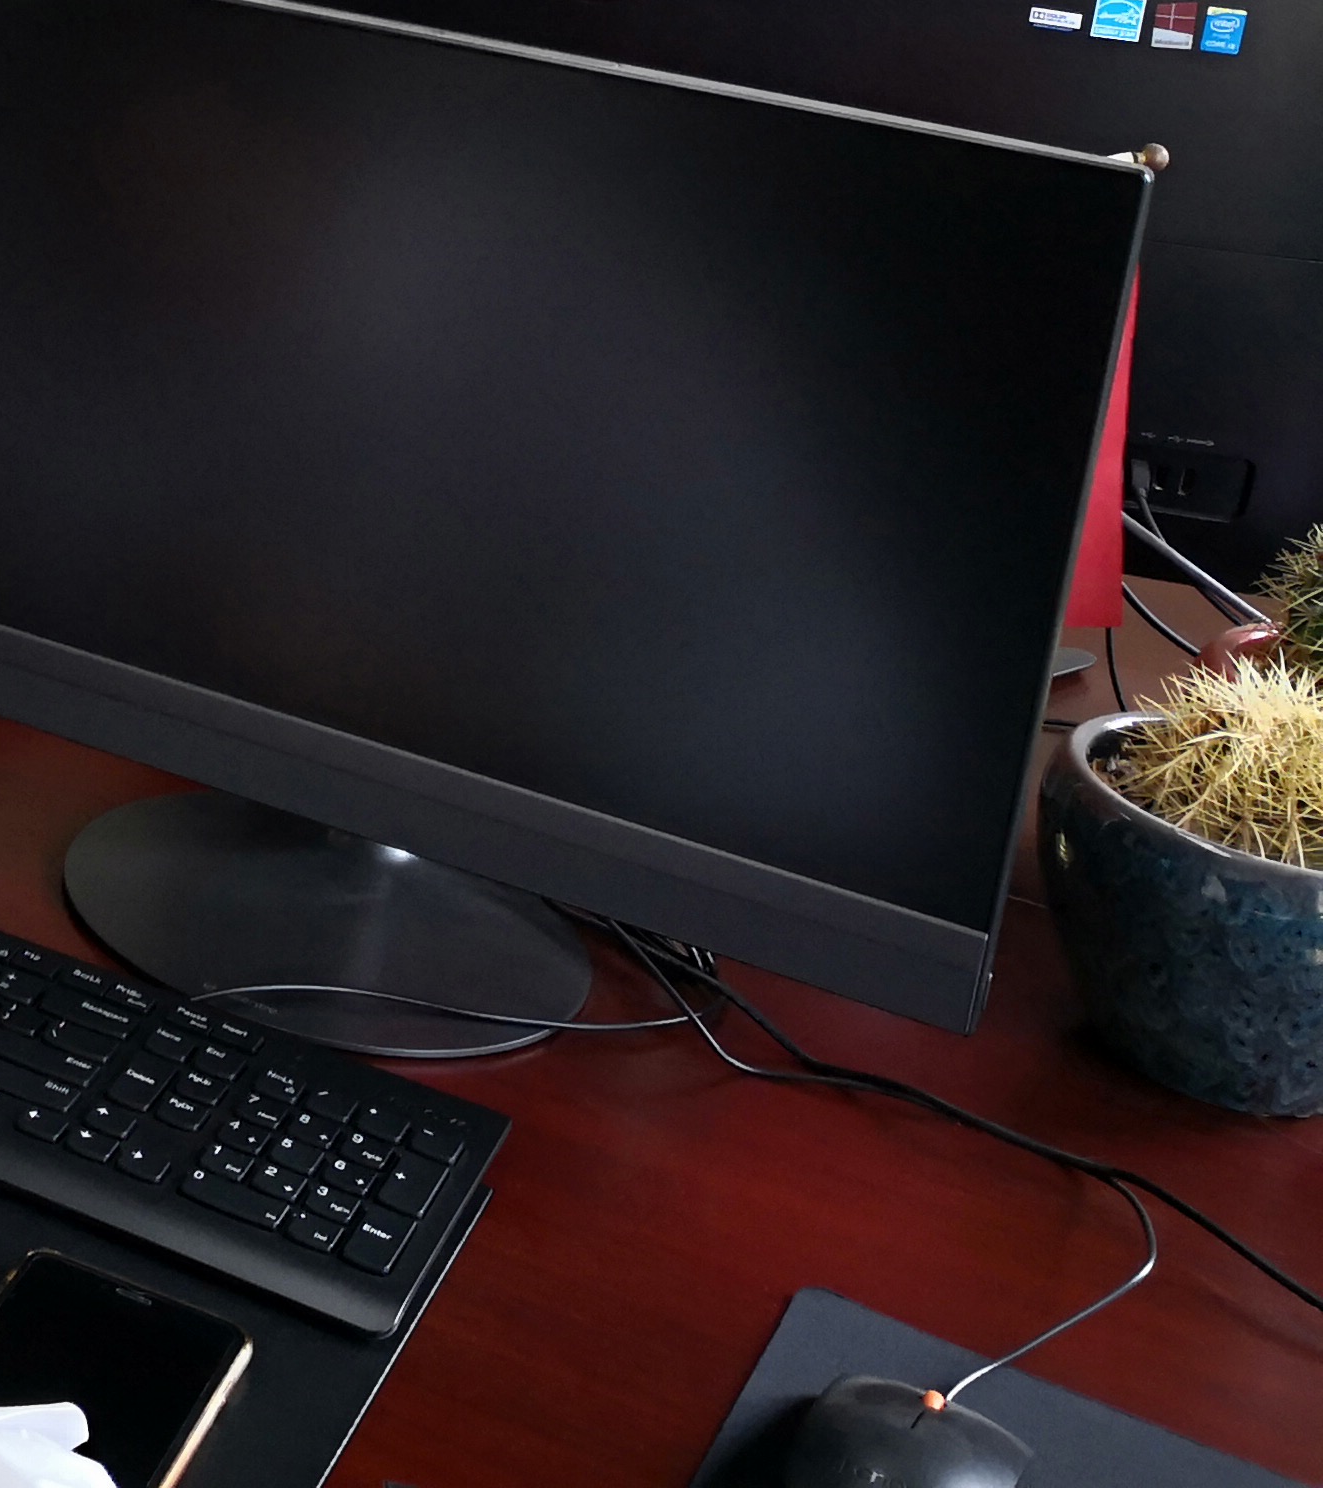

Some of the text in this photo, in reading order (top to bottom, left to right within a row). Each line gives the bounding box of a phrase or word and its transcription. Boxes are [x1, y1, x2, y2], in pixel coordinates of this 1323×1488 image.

[82, 1001, 129, 1023] Backspace
[177, 1006, 207, 1022] Pause
[157, 1028, 181, 1042] Home
[222, 1024, 248, 1037] Insert
[206, 1046, 226, 1058] End
[126, 1068, 155, 1085] Delete
[45, 1081, 70, 1095] Shift
[169, 1097, 194, 1111] PgDn
[248, 1094, 260, 1104] 7
[299, 1114, 310, 1124] 8
[229, 1120, 240, 1130] 4
[281, 1138, 293, 1148] 5
[352, 1134, 364, 1143] 9
[214, 1145, 222, 1154] 1
[335, 1160, 346, 1170] 6
[193, 1170, 205, 1179] 0
[264, 1166, 278, 1176] 2
[317, 1186, 329, 1196] 3
[362, 1223, 392, 1241] Enter
